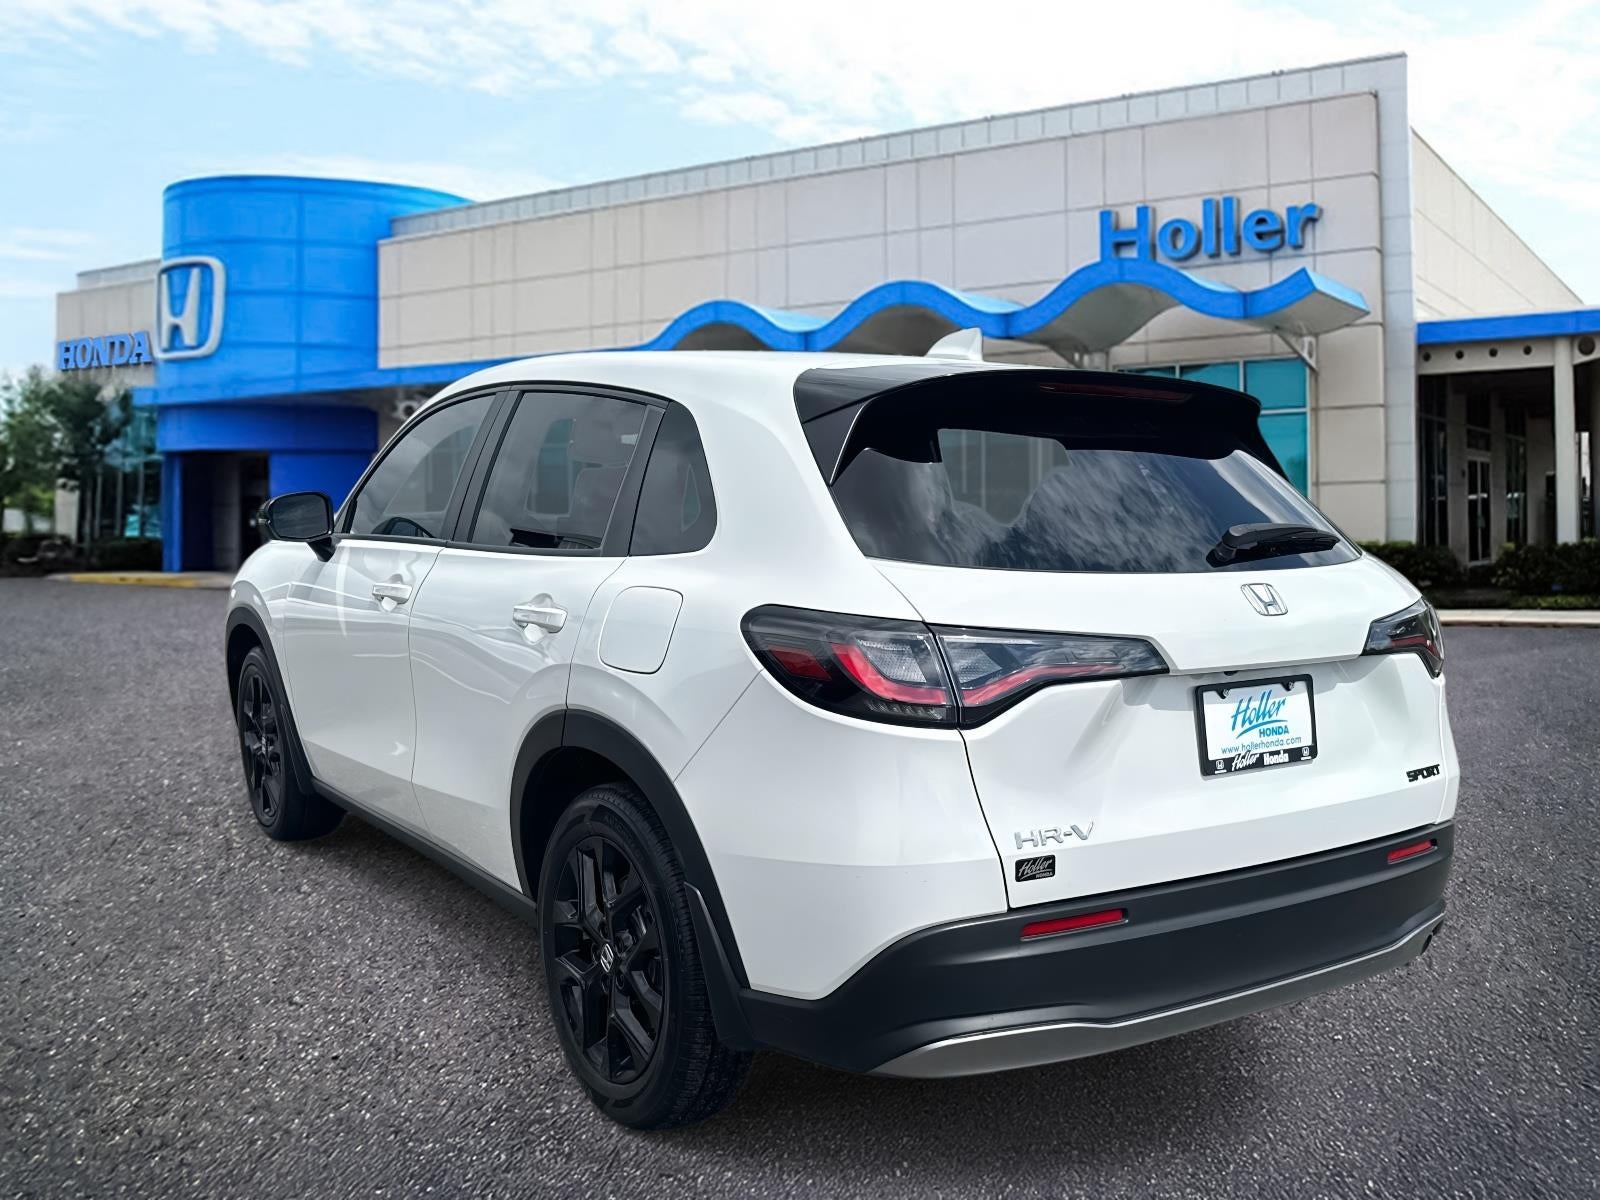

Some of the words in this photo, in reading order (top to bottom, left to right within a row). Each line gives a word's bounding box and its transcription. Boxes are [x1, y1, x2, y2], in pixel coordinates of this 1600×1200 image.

[1099, 195, 1321, 262] Holler
[58, 331, 152, 370] HONDA
[1231, 689, 1286, 731] Holler
[1259, 725, 1289, 738] HONDA
[1232, 750, 1260, 771] Holler
[1263, 750, 1289, 765] Honda
[1406, 764, 1440, 782] SPORT
[1014, 821, 1093, 849] HR-V
[1019, 857, 1052, 876] Holler
